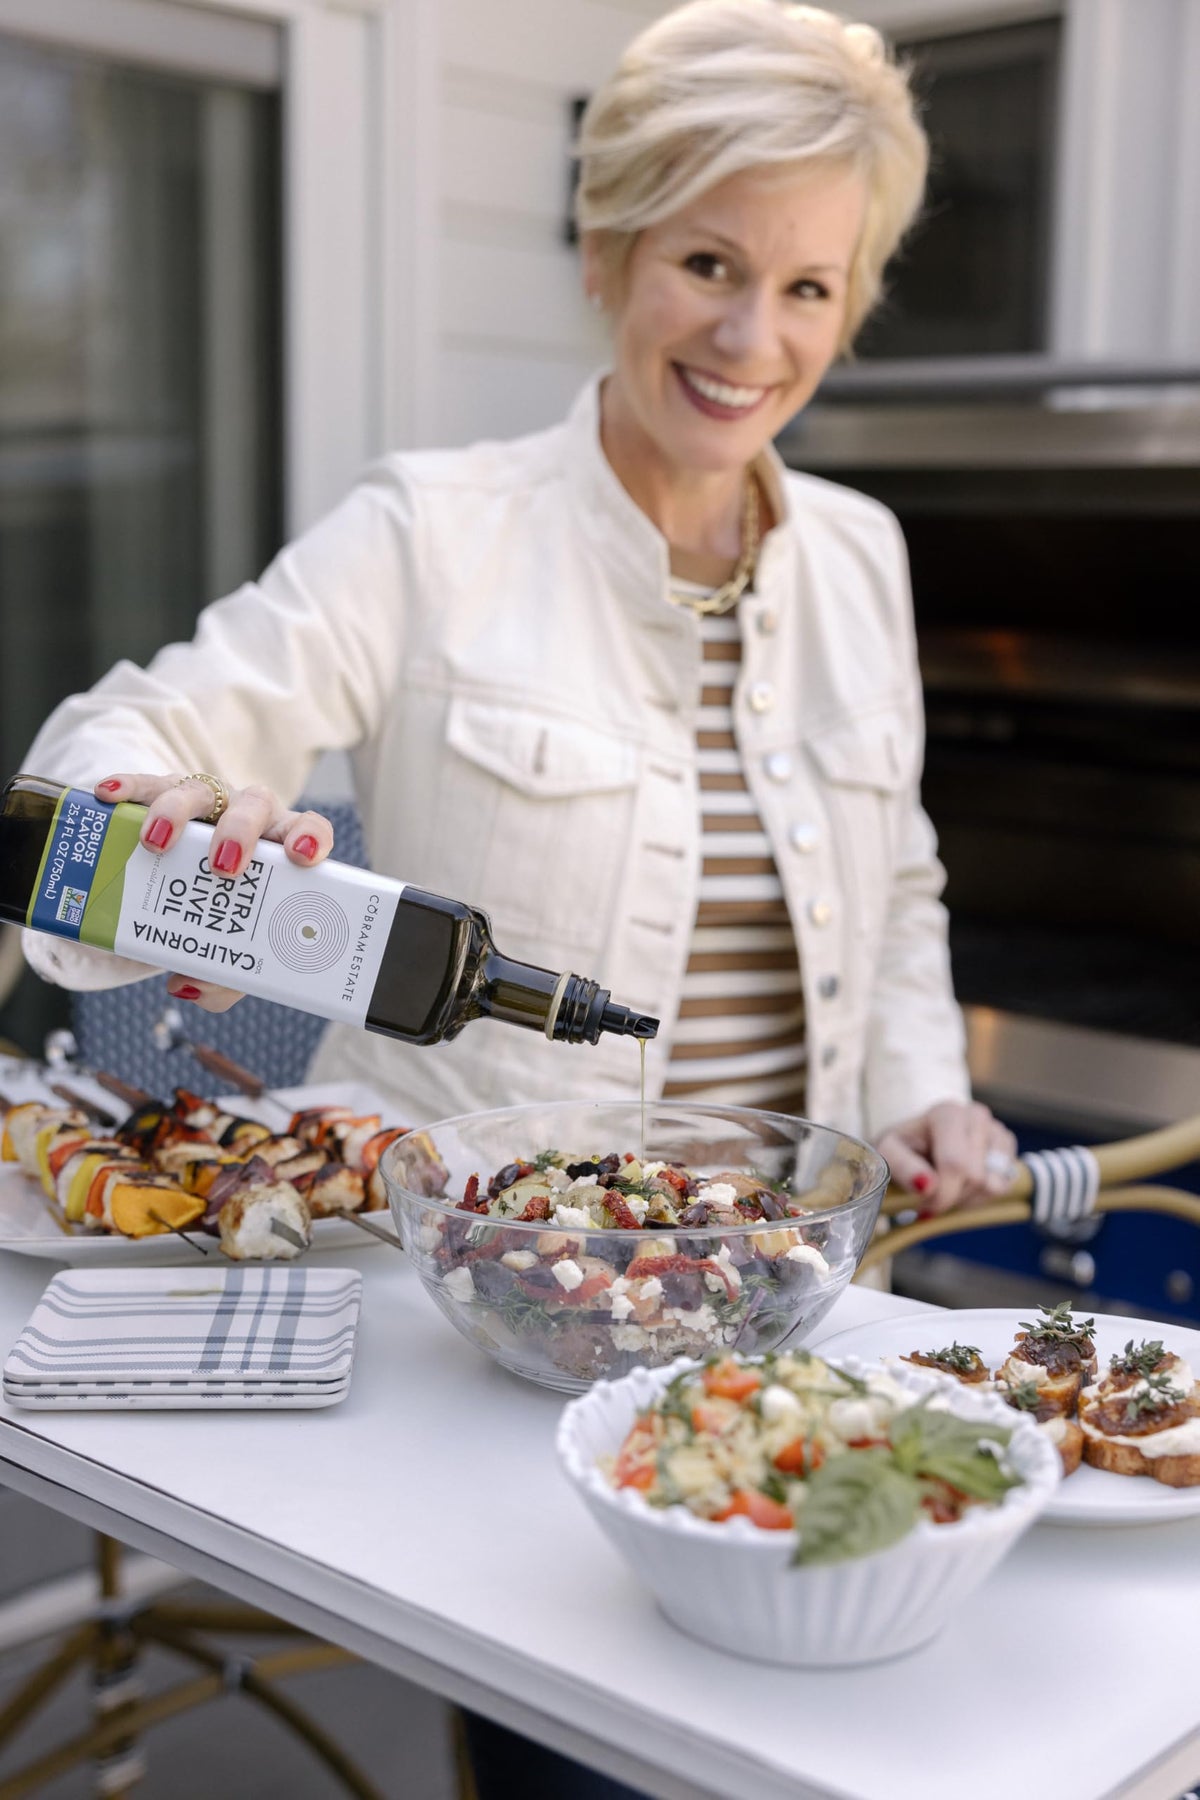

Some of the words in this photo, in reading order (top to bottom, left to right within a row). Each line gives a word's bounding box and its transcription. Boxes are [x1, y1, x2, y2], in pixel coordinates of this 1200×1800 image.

[61, 826, 74, 838] FL
[65, 802, 81, 826] 25.4
[70, 808, 96, 863] FLAVOR
[56, 841, 70, 858] OZ
[82, 811, 108, 867] ROBUST
[44, 857, 65, 900] (750mL)
[161, 878, 188, 916] OIL
[226, 859, 264, 934] EXTRA
[204, 876, 236, 932] RGIN
[355, 894, 380, 953] COBRAM
[133, 920, 256, 971] CALIFORNIA
[341, 955, 363, 1002] ESTATE
